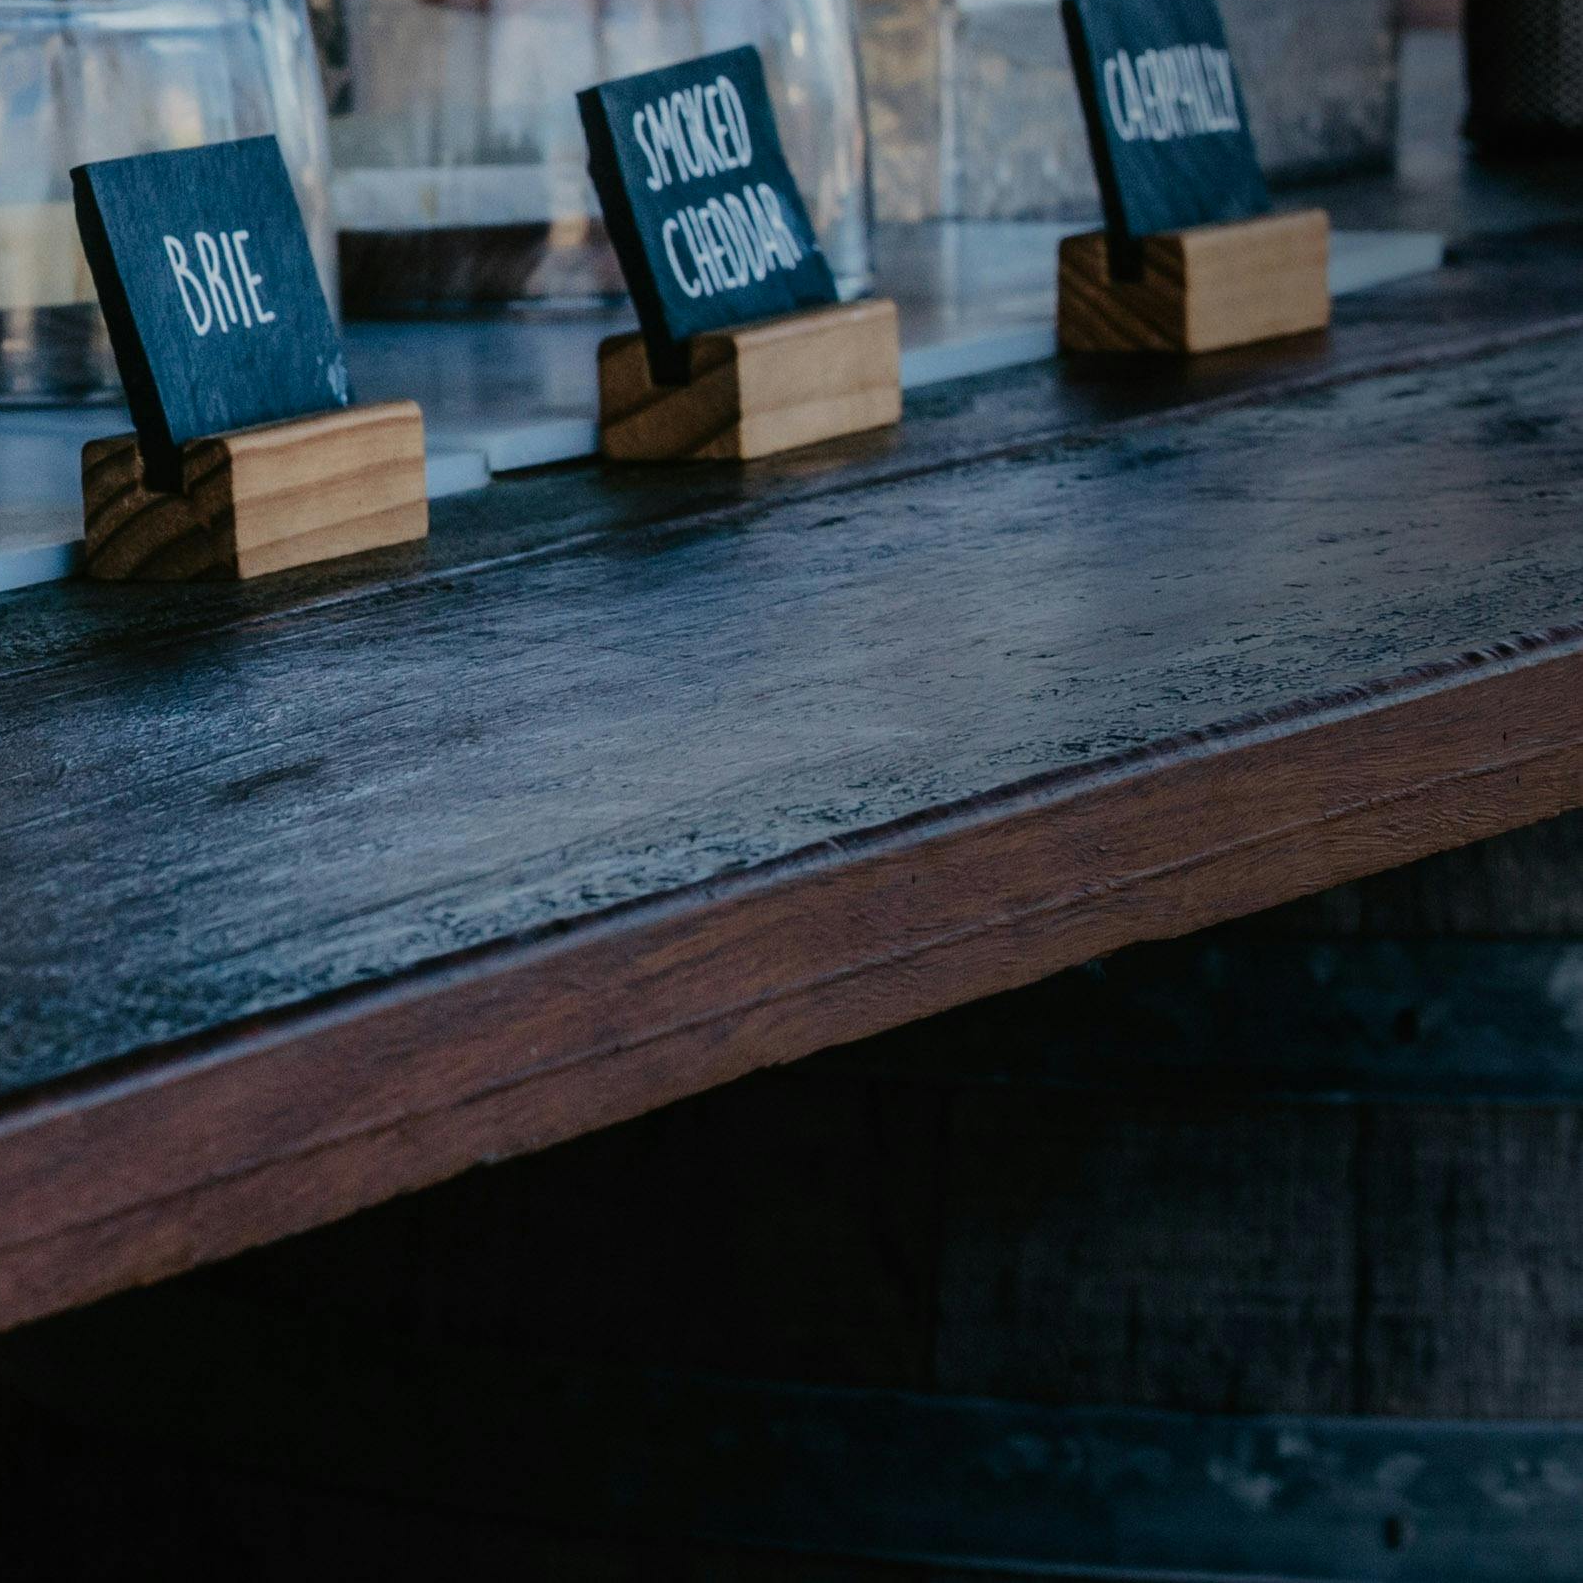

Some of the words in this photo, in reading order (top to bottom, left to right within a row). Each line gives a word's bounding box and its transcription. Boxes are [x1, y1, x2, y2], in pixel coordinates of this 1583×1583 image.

[634, 75, 752, 192] SMOKED
[163, 230, 276, 336] BRIE
[662, 182, 802, 298] CHEDDAR
